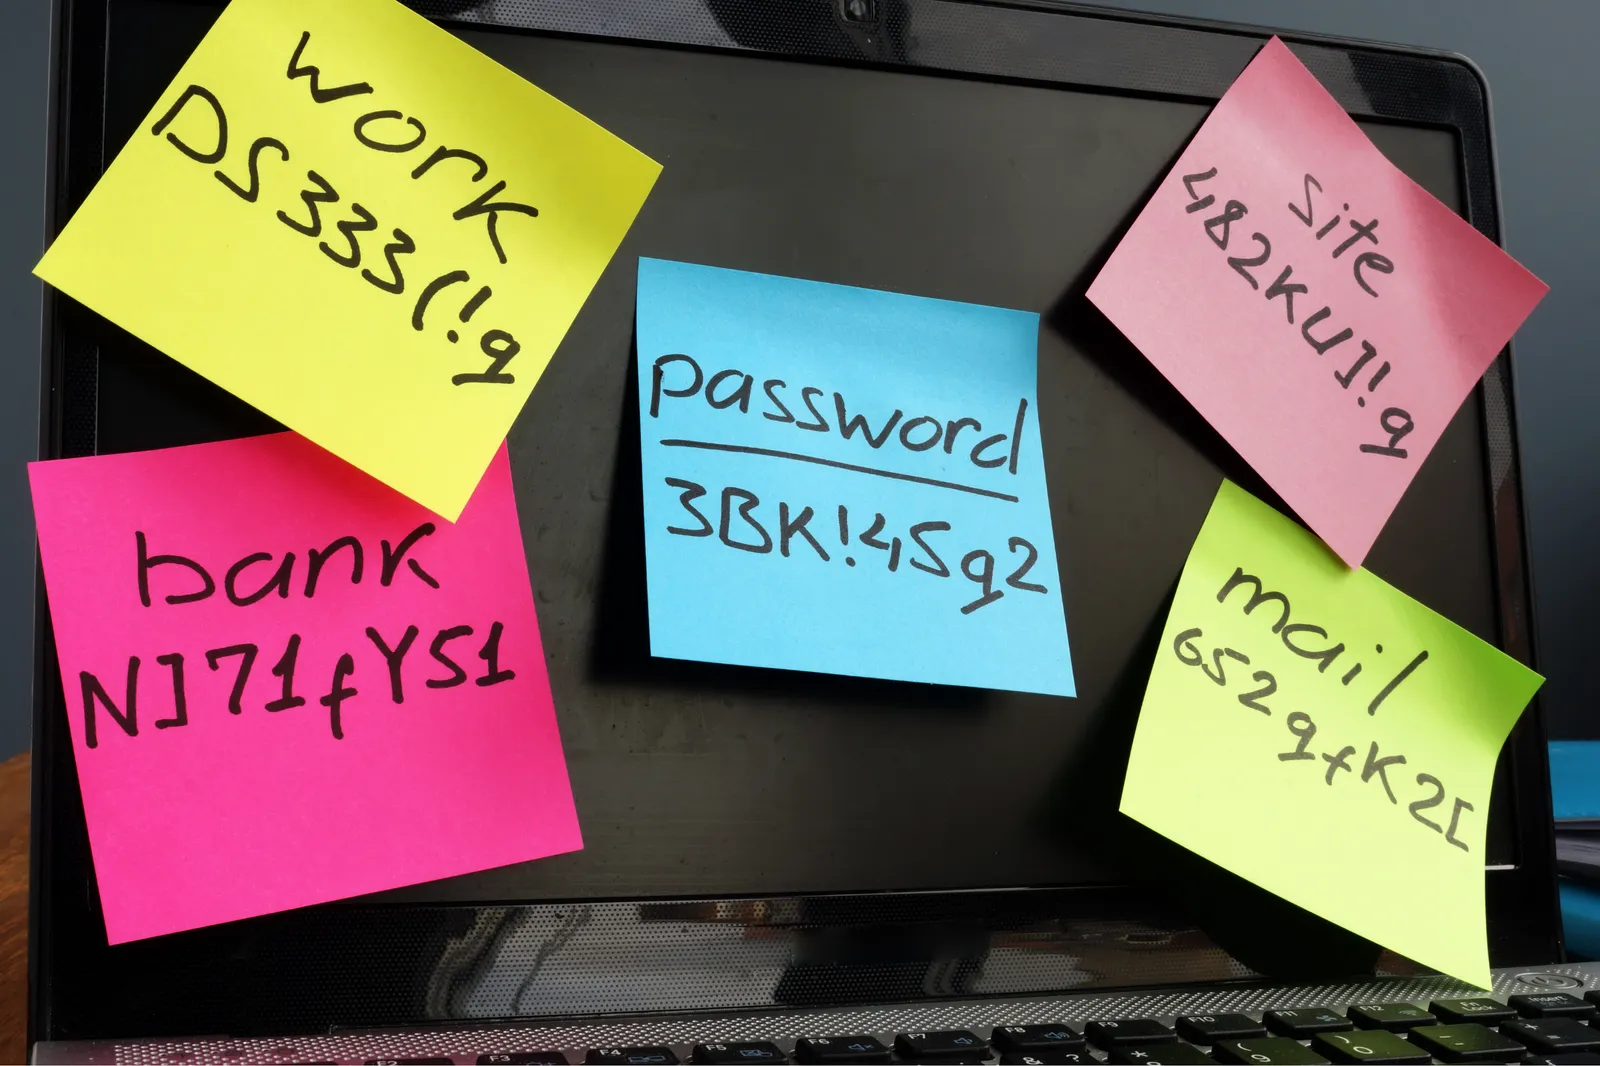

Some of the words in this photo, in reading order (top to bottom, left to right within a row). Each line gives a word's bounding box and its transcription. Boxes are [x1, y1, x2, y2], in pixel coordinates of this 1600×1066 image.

[286, 30, 539, 265] work
[1288, 173, 1394, 298] site
[650, 353, 1028, 475] password
[135, 522, 440, 608] bank
[1216, 566, 1429, 716] mail
[1188, 1016, 1215, 1024] F10
[1275, 1010, 1299, 1018] F11
